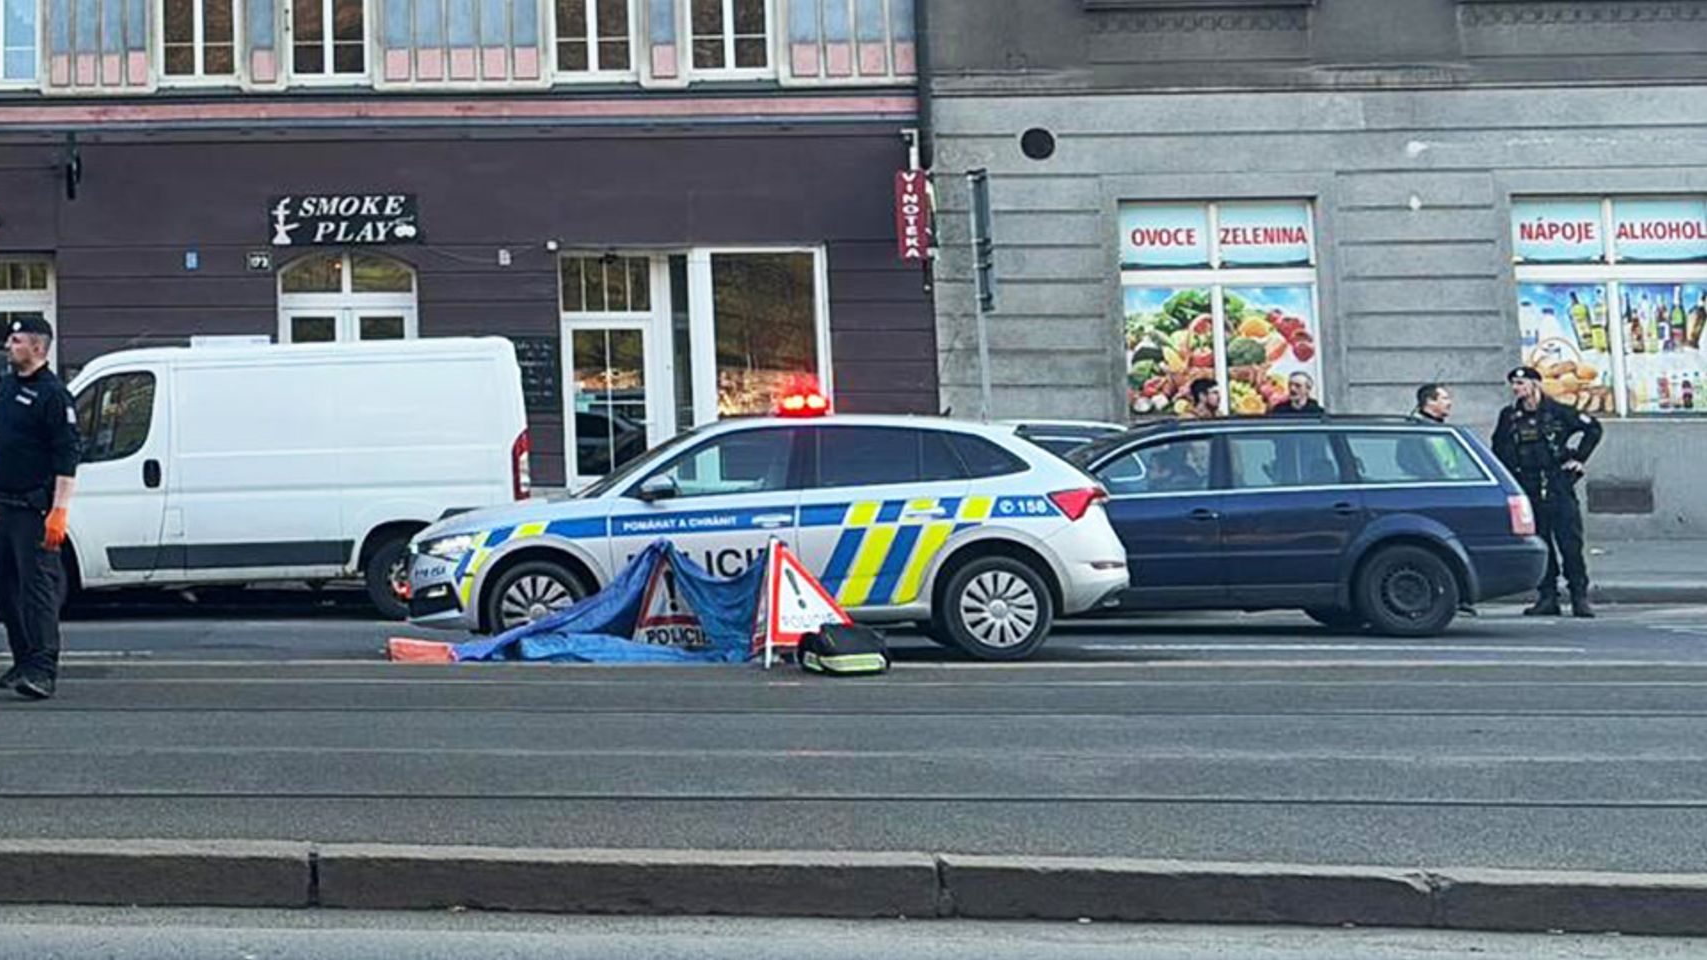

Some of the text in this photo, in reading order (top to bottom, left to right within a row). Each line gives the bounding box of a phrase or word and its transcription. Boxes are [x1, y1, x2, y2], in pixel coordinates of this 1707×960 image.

[299, 195, 406, 217] SMOKE
[901, 171, 921, 258] VINOTEKA
[313, 221, 395, 243] PLAY
[1130, 226, 1308, 247] OVOCE ZELENINA
[1519, 216, 1707, 244] NÁPOJE ALKOHOL
[678, 518, 688, 529] A
